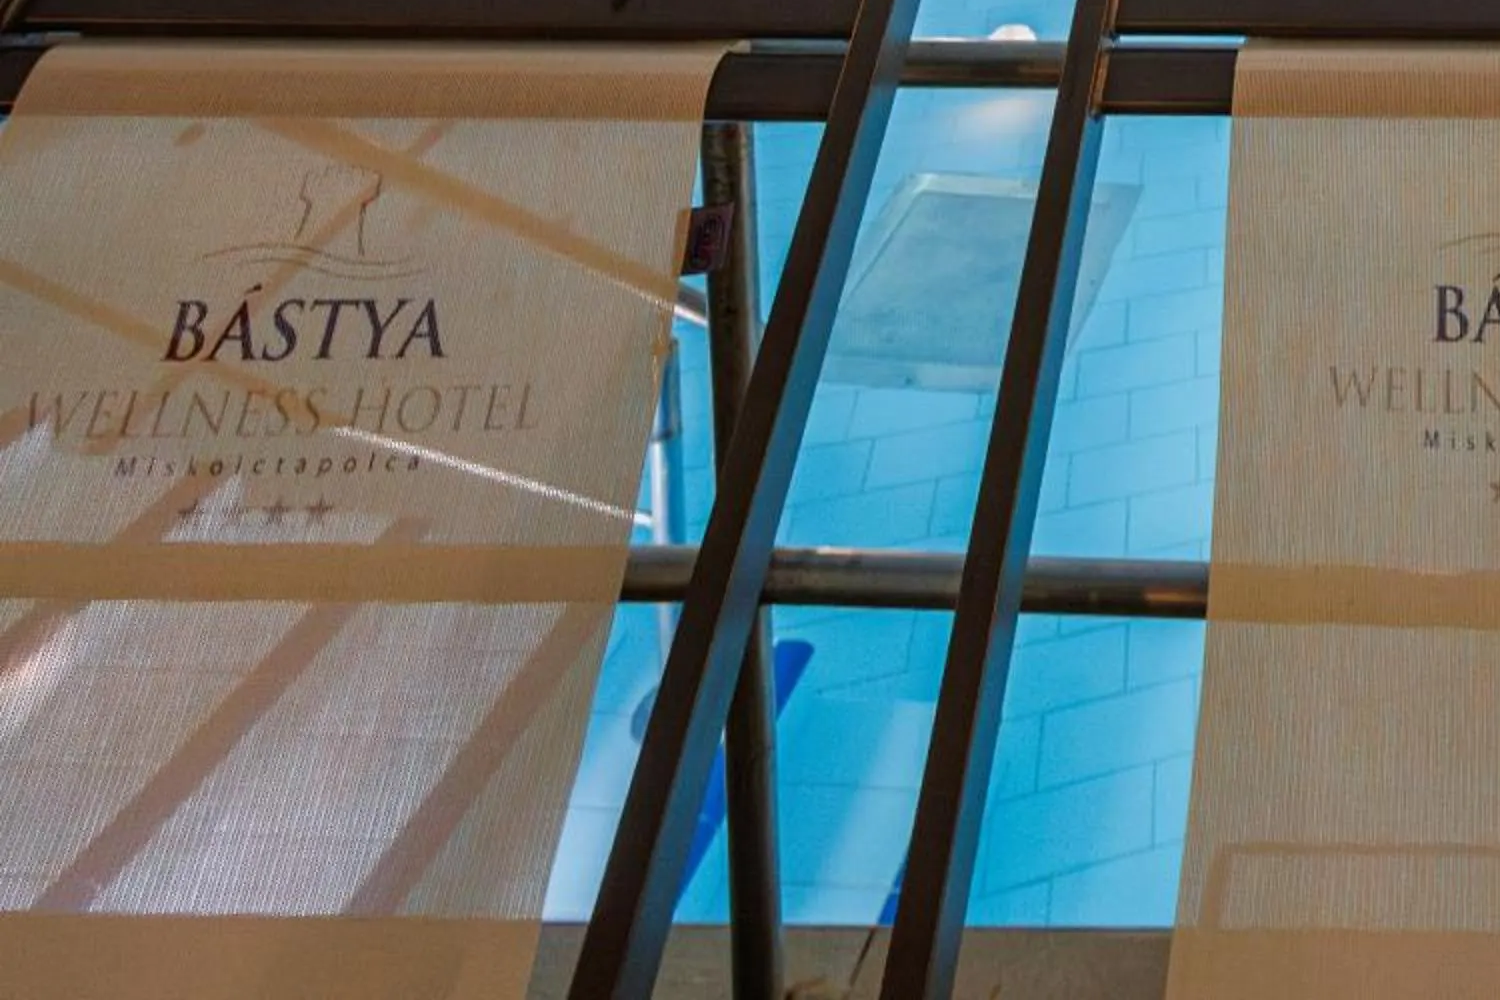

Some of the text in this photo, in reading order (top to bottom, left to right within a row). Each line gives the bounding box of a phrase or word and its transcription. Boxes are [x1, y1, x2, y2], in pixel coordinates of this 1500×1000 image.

[161, 281, 448, 364] BÁSTYA
[26, 382, 540, 439] WELLNESS HOTEL
